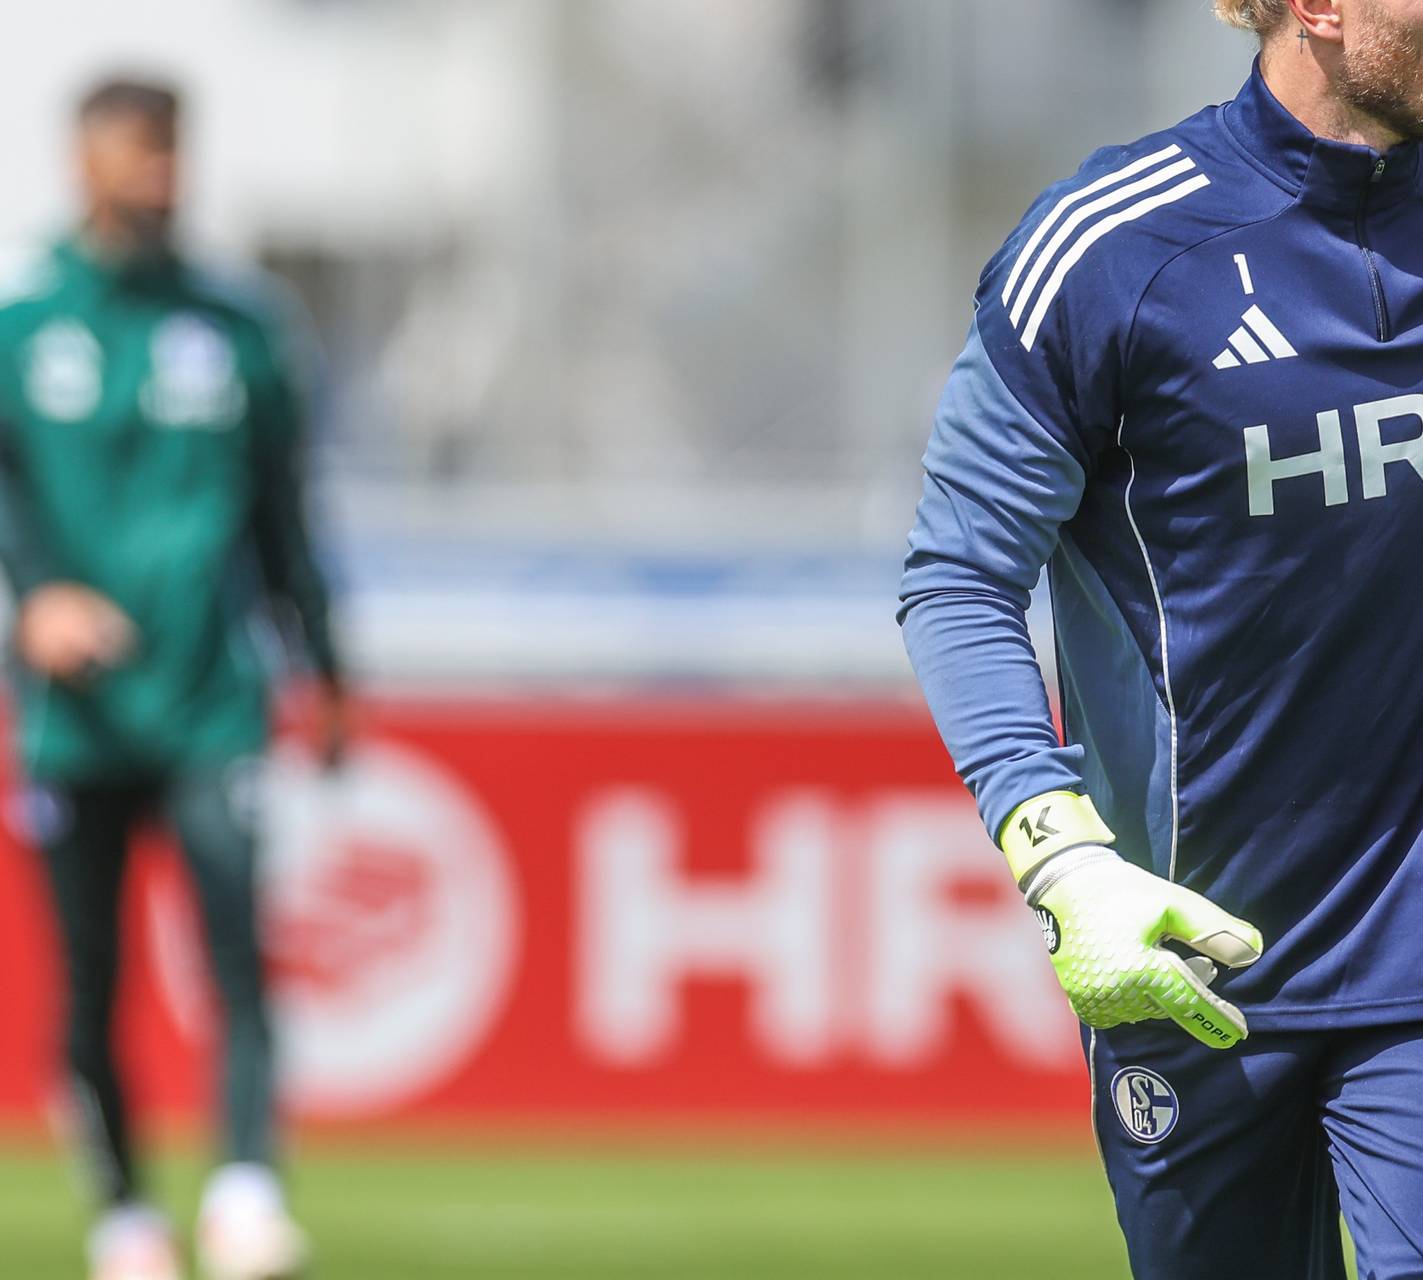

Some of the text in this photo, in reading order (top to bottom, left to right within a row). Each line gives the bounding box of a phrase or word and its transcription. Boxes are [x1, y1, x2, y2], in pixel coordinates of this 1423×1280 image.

[1233, 253, 1255, 295] 1
[1192, 1012, 1232, 1041] POPE
[1134, 1109, 1152, 1134] 04
